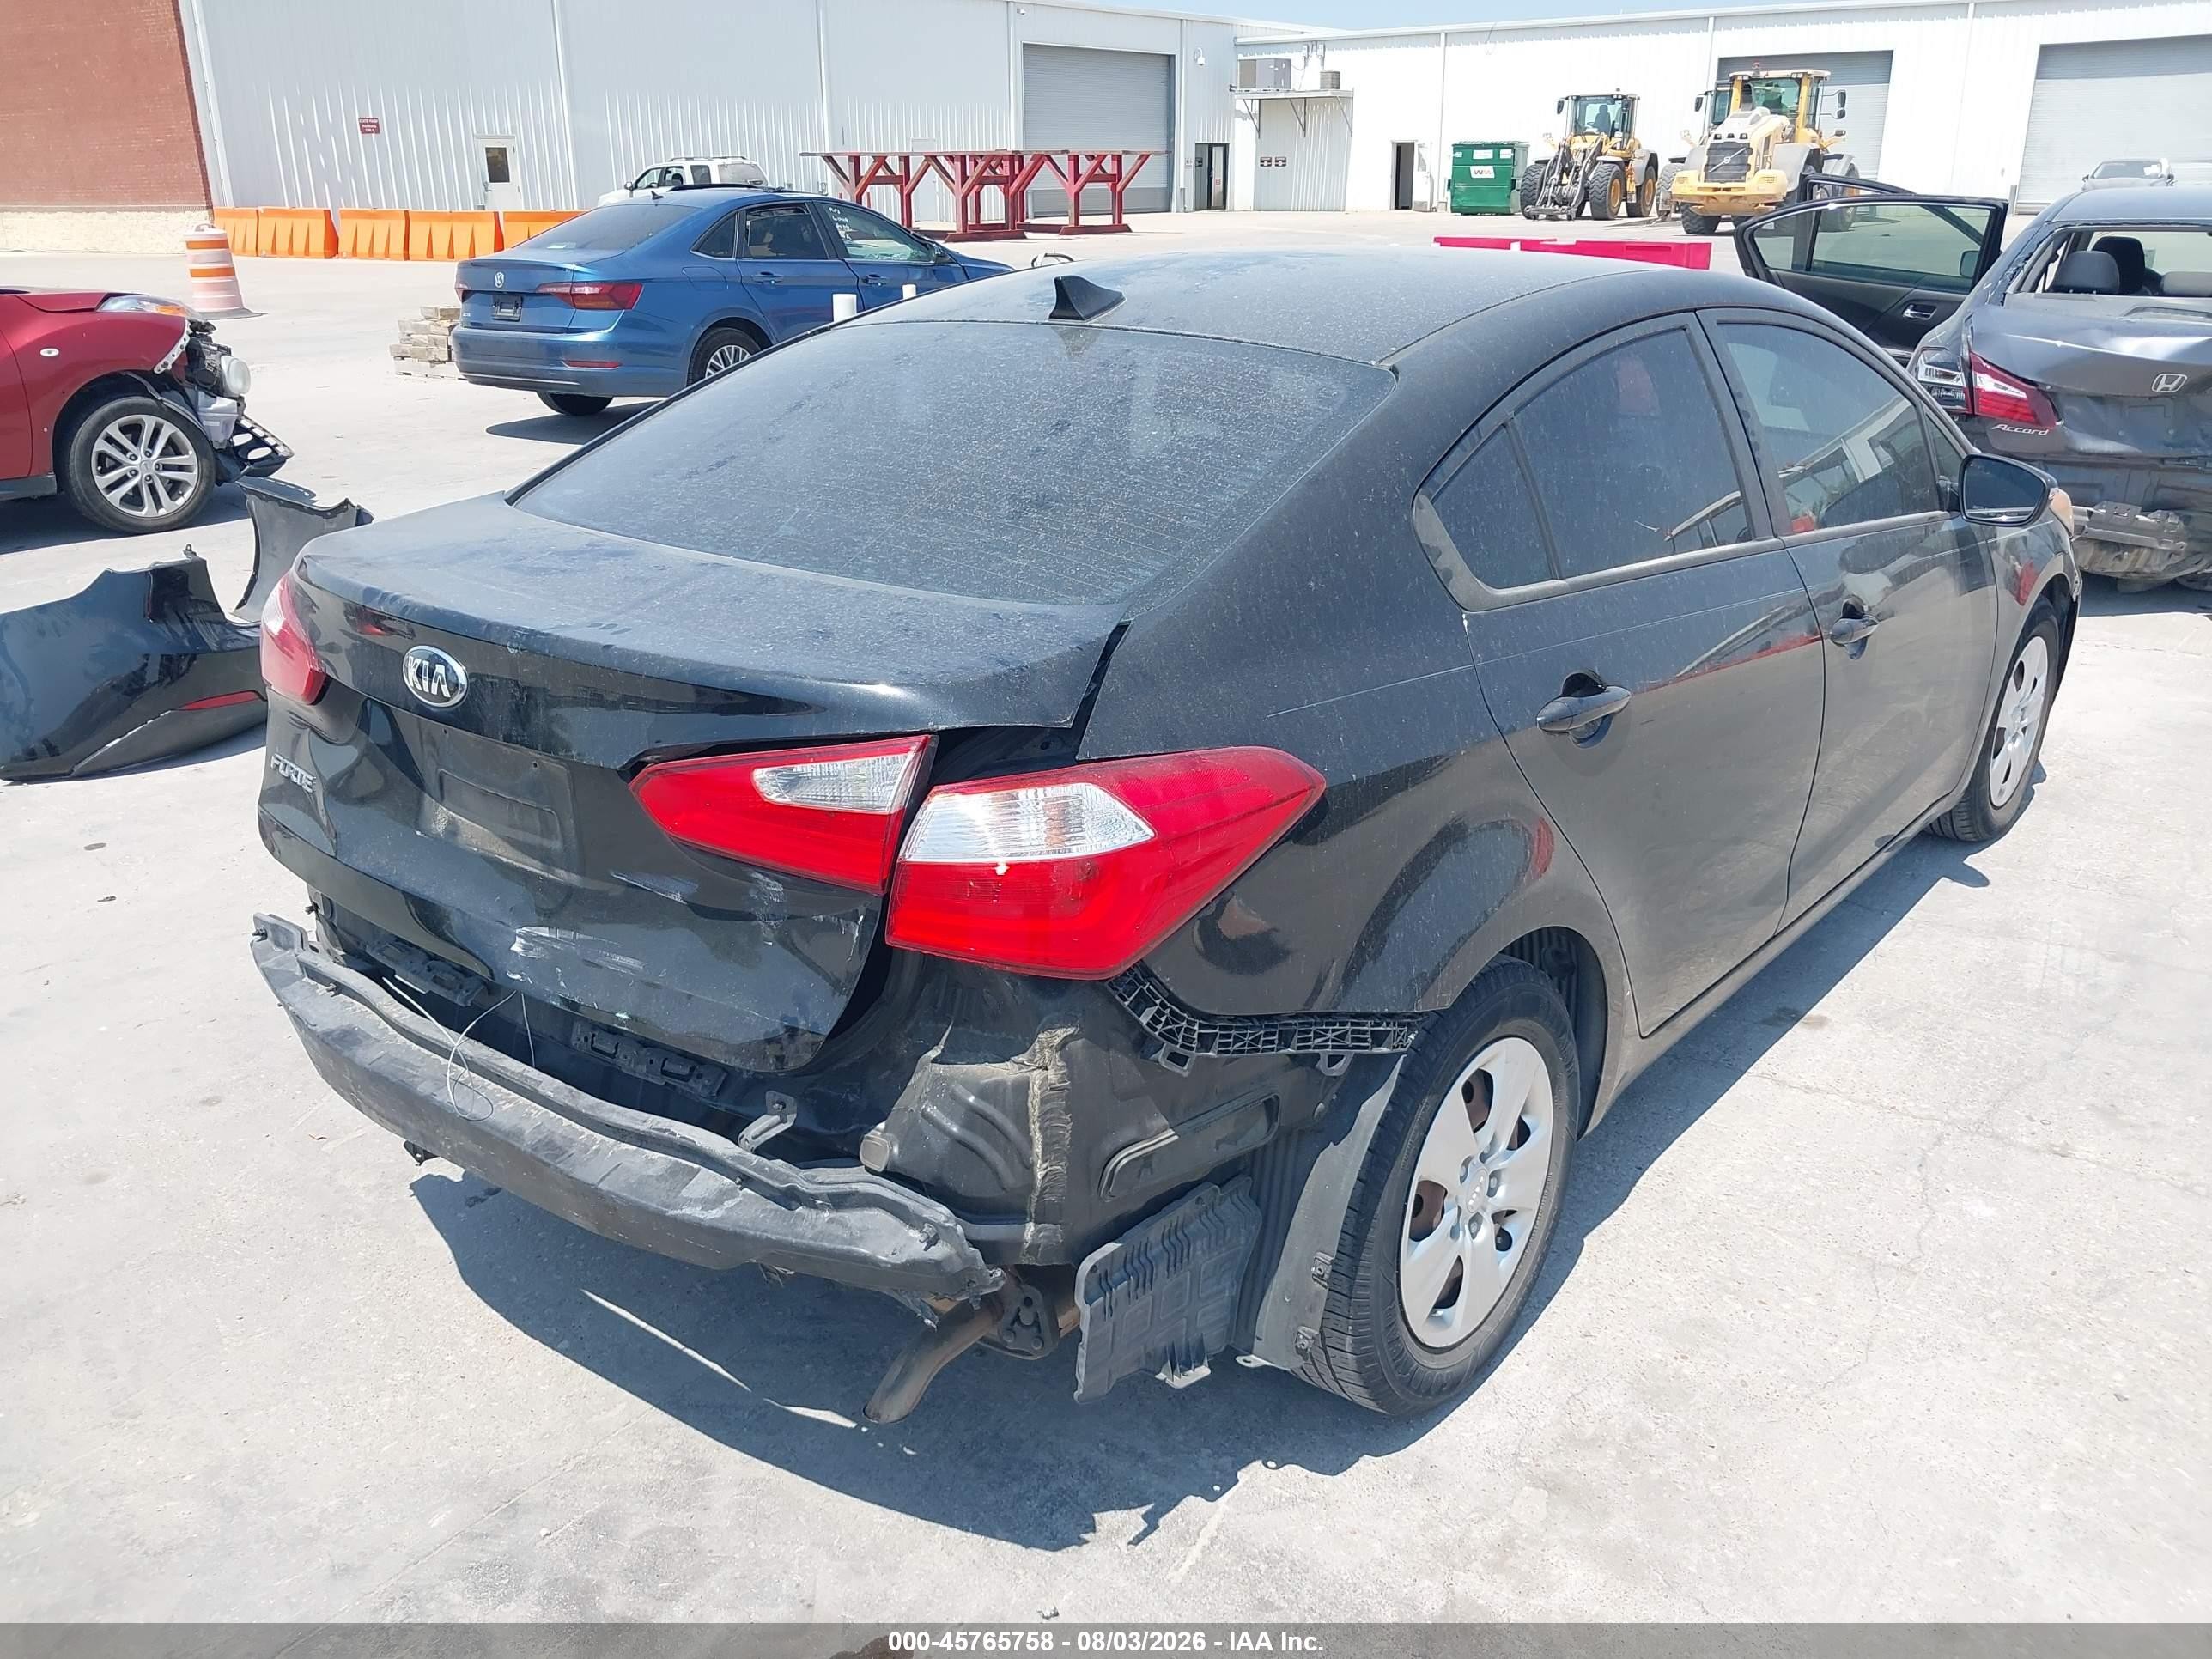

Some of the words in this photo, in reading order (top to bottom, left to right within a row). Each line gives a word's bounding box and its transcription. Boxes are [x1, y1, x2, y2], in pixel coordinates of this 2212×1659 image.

[1992, 423, 2050, 435] Accord
[408, 655, 452, 698] KIA
[270, 753, 315, 793] FORTE
